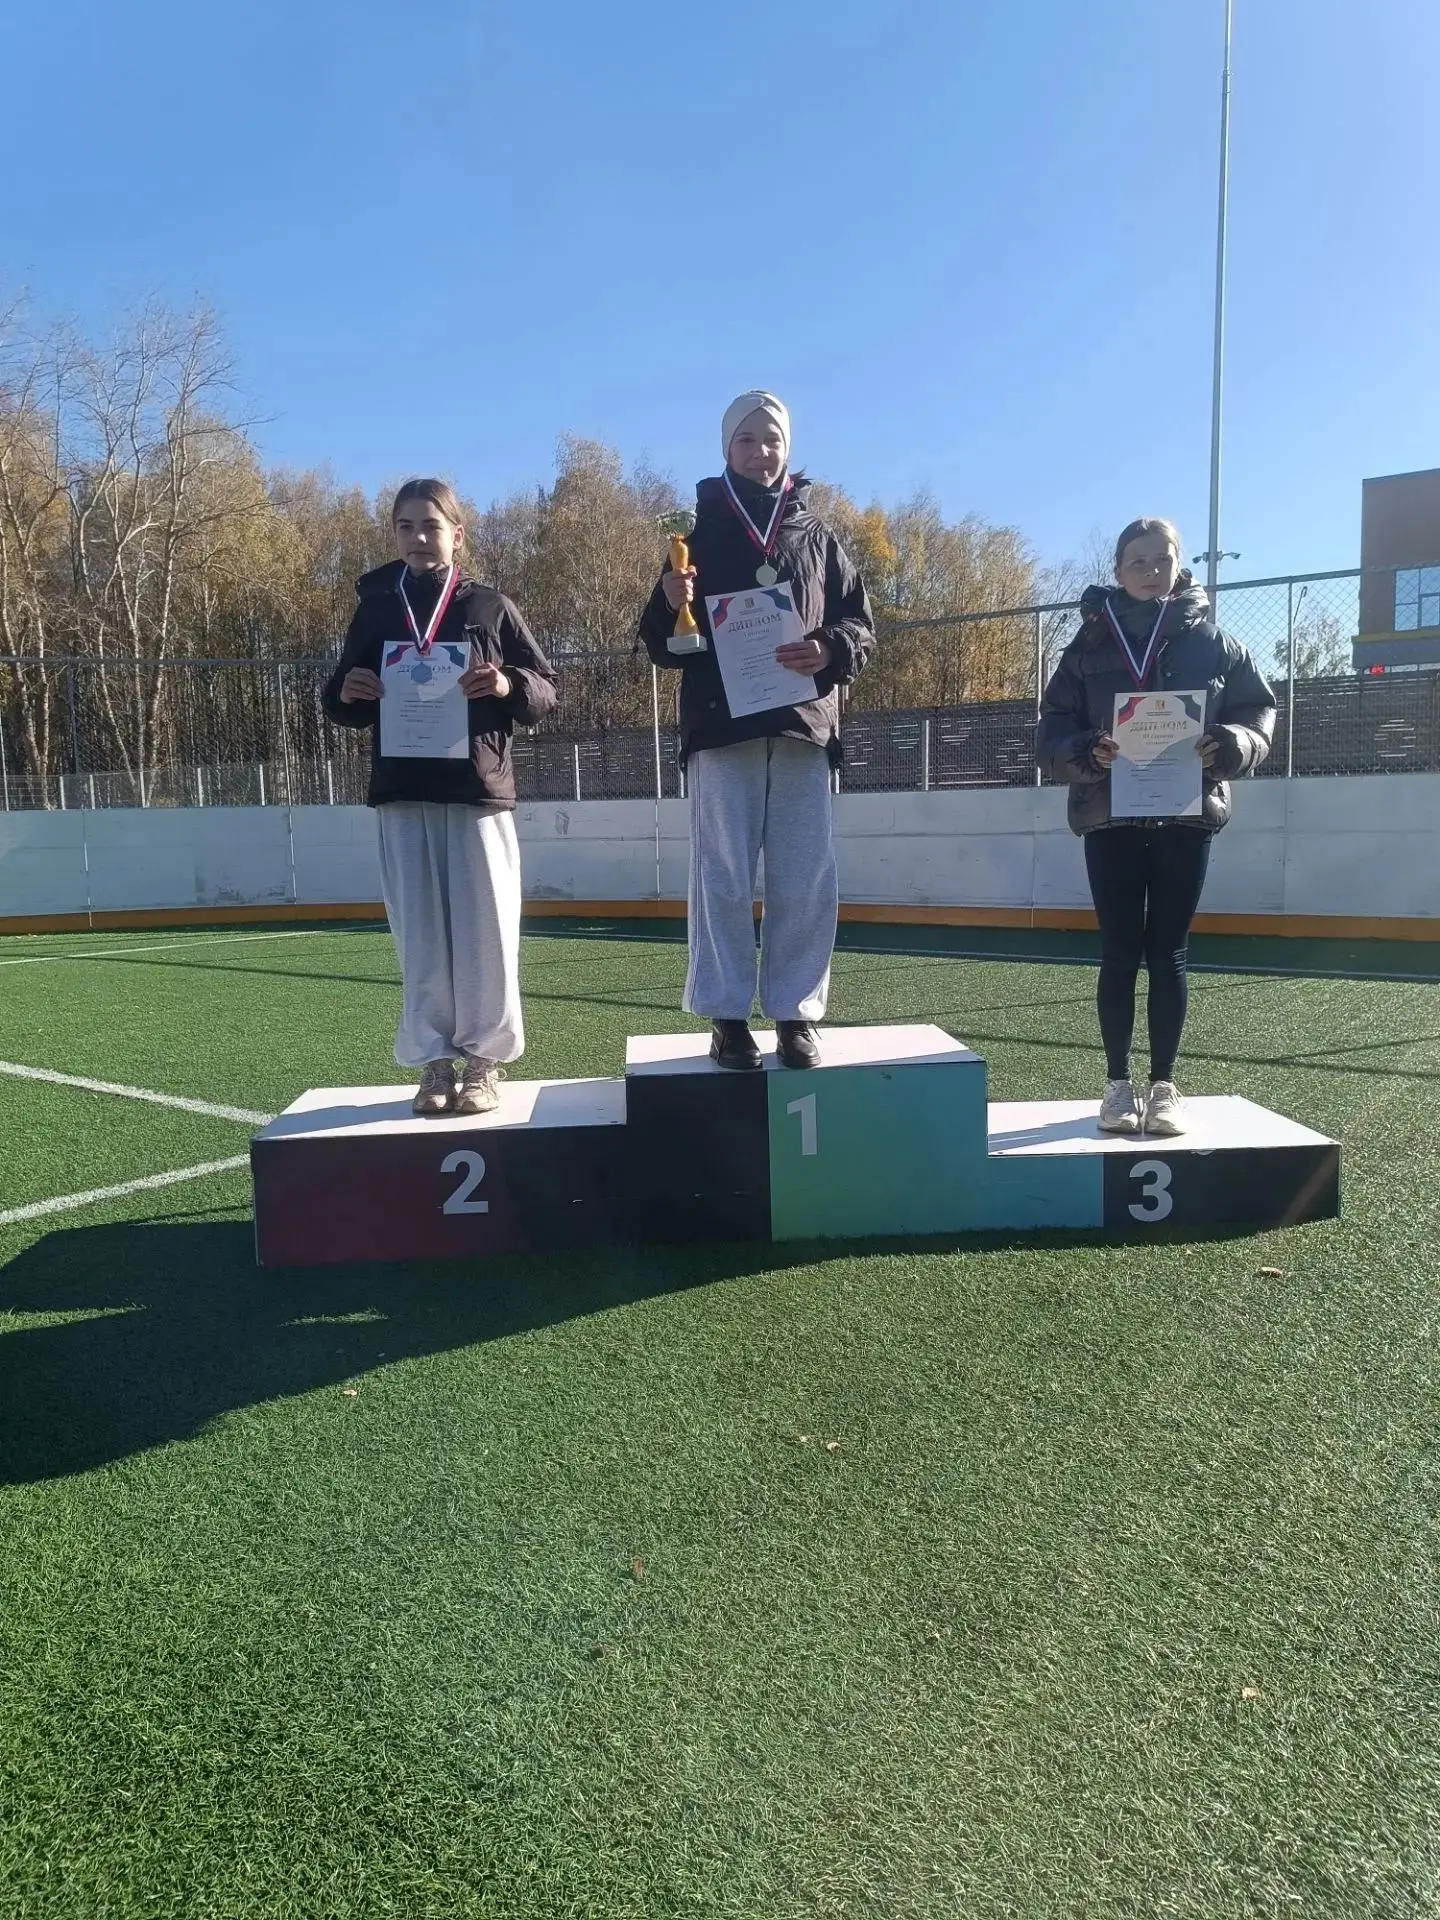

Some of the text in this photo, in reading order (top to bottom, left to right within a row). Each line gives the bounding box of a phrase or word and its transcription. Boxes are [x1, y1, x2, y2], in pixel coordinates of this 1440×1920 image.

[786, 1092, 818, 1156] 1
[440, 1149, 489, 1215] 2
[1128, 1159, 1173, 1222] 3
